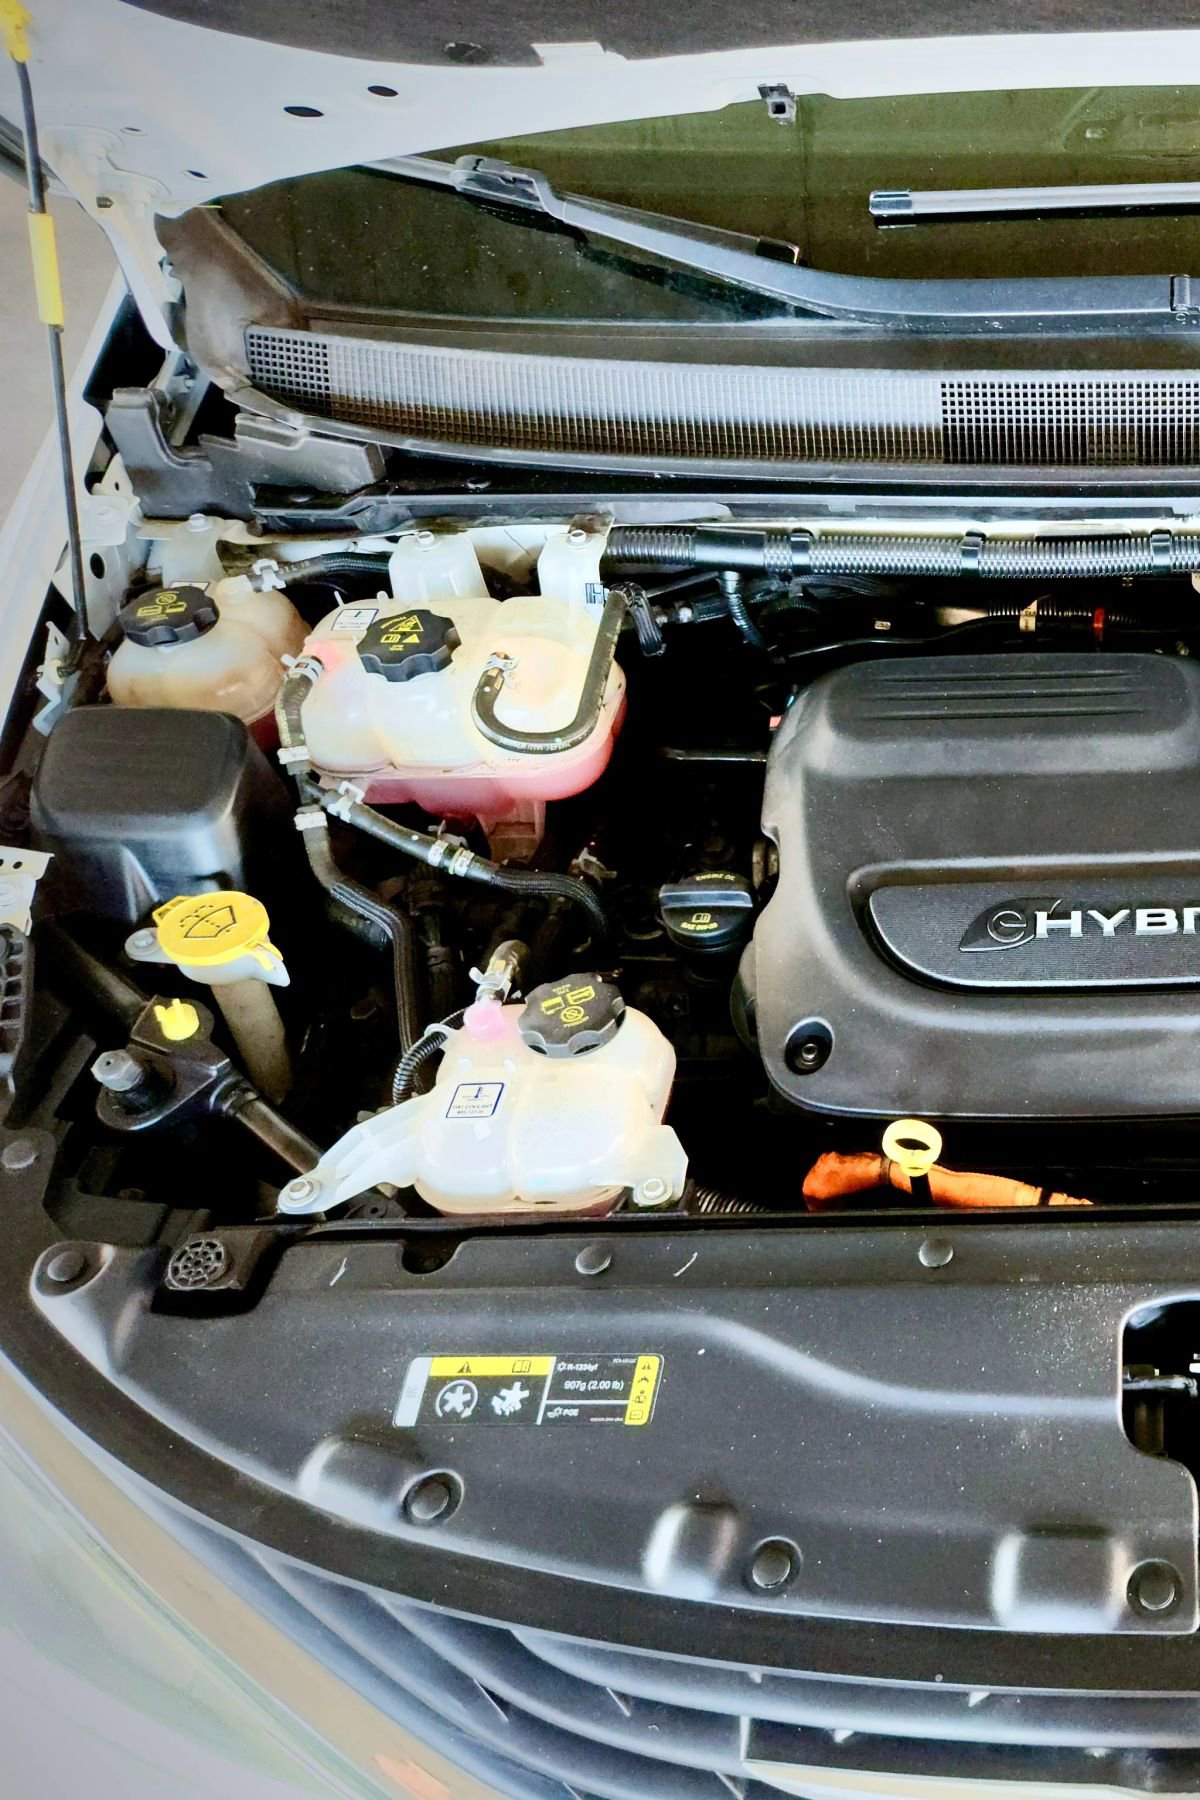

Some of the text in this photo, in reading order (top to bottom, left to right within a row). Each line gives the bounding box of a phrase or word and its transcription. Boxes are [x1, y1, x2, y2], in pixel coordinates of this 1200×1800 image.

[564, 1380, 624, 1391] 907g (2.00 lb)
